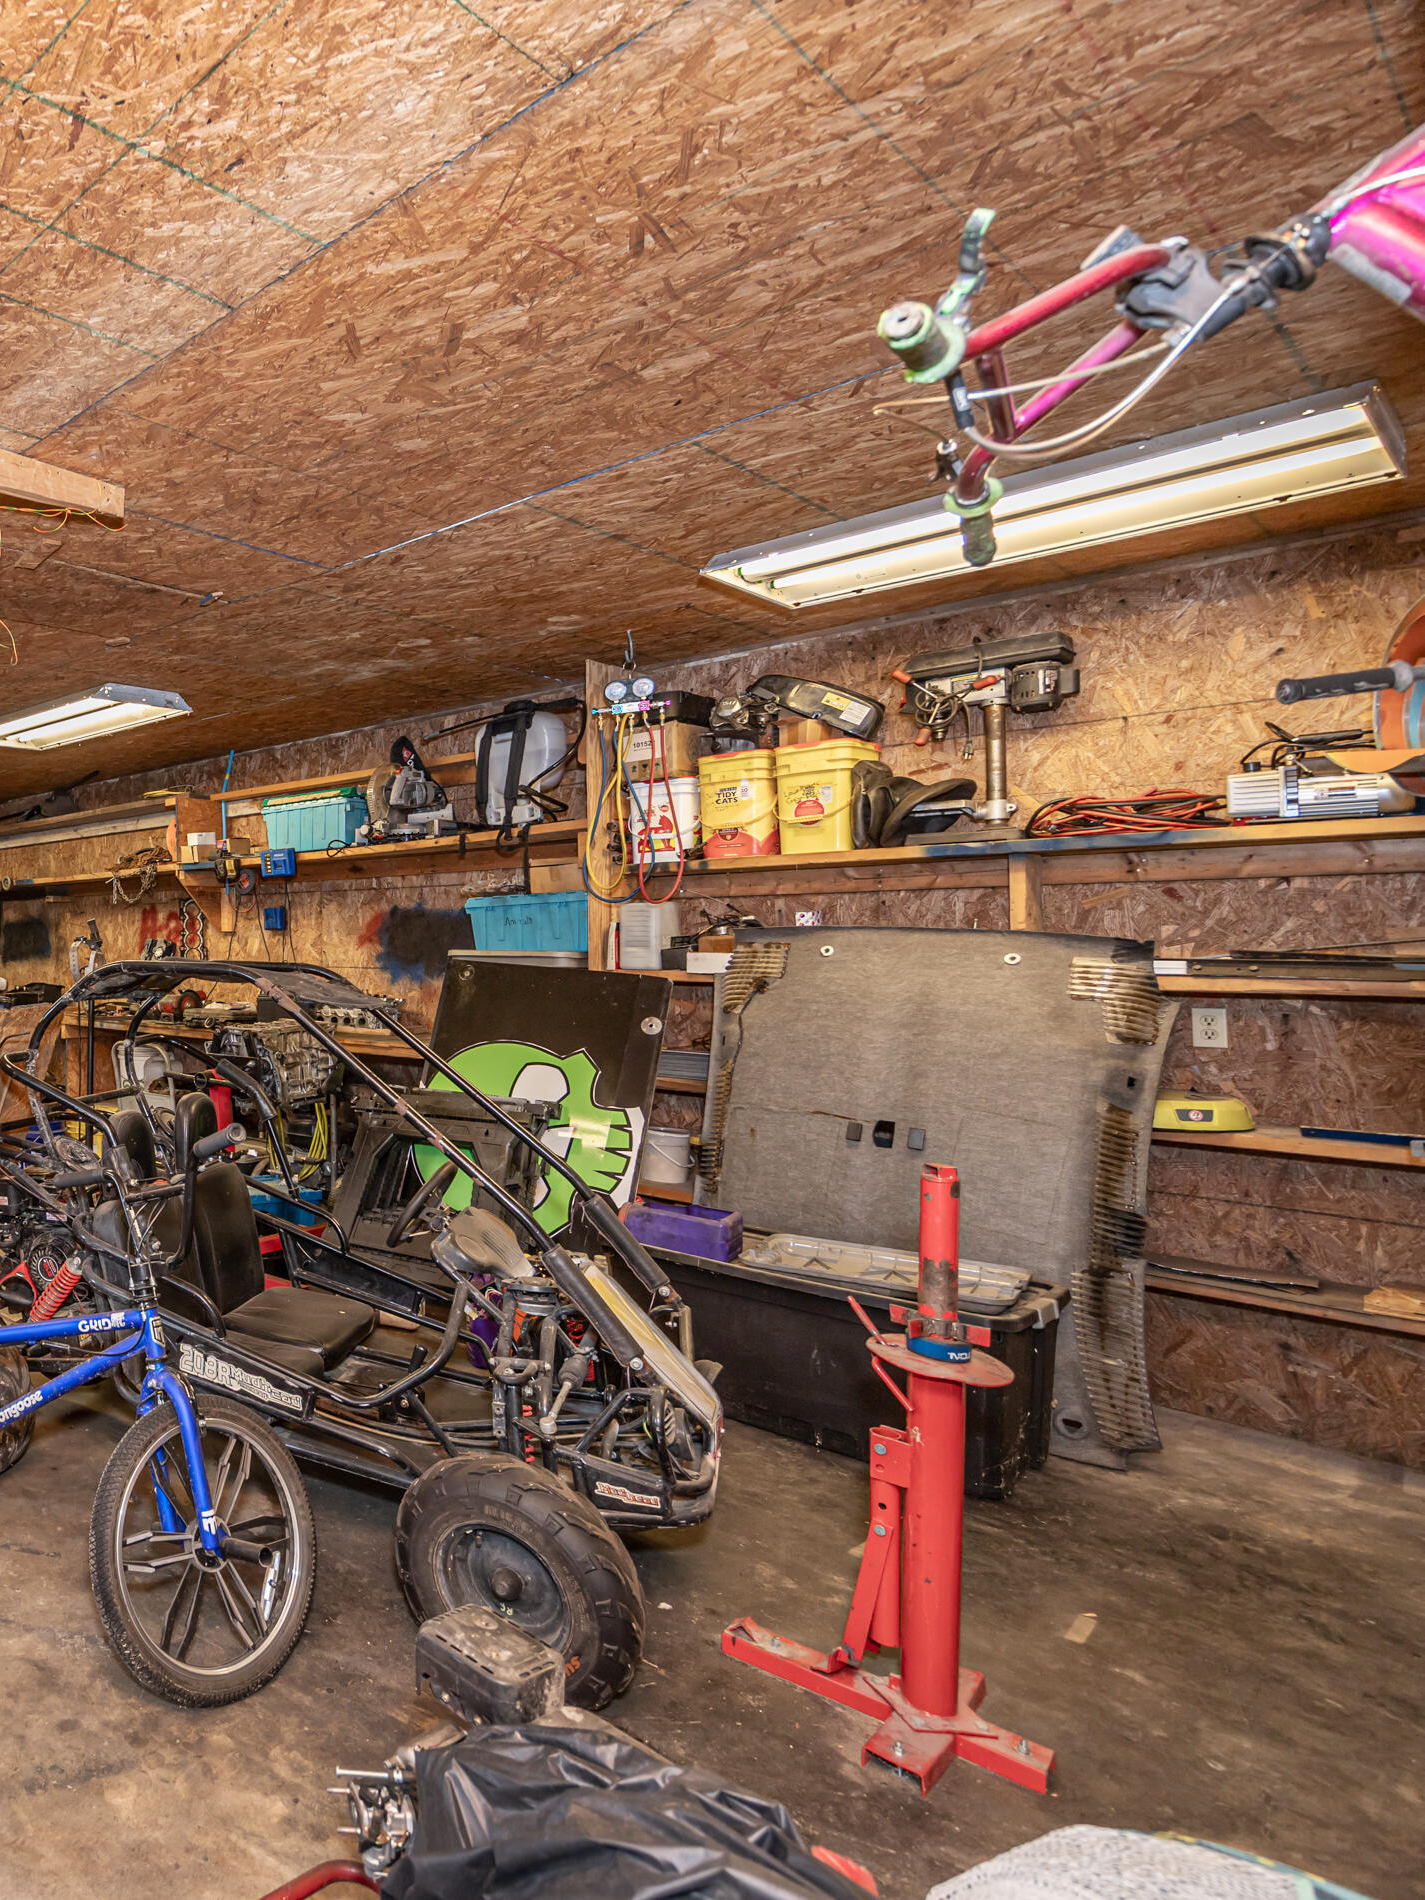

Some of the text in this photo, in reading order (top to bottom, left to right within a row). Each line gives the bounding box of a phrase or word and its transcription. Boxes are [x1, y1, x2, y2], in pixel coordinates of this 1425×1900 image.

[715, 791, 736, 799] TIDY
[715, 797, 738, 805] CATS
[78, 1318, 112, 1333] GRID
